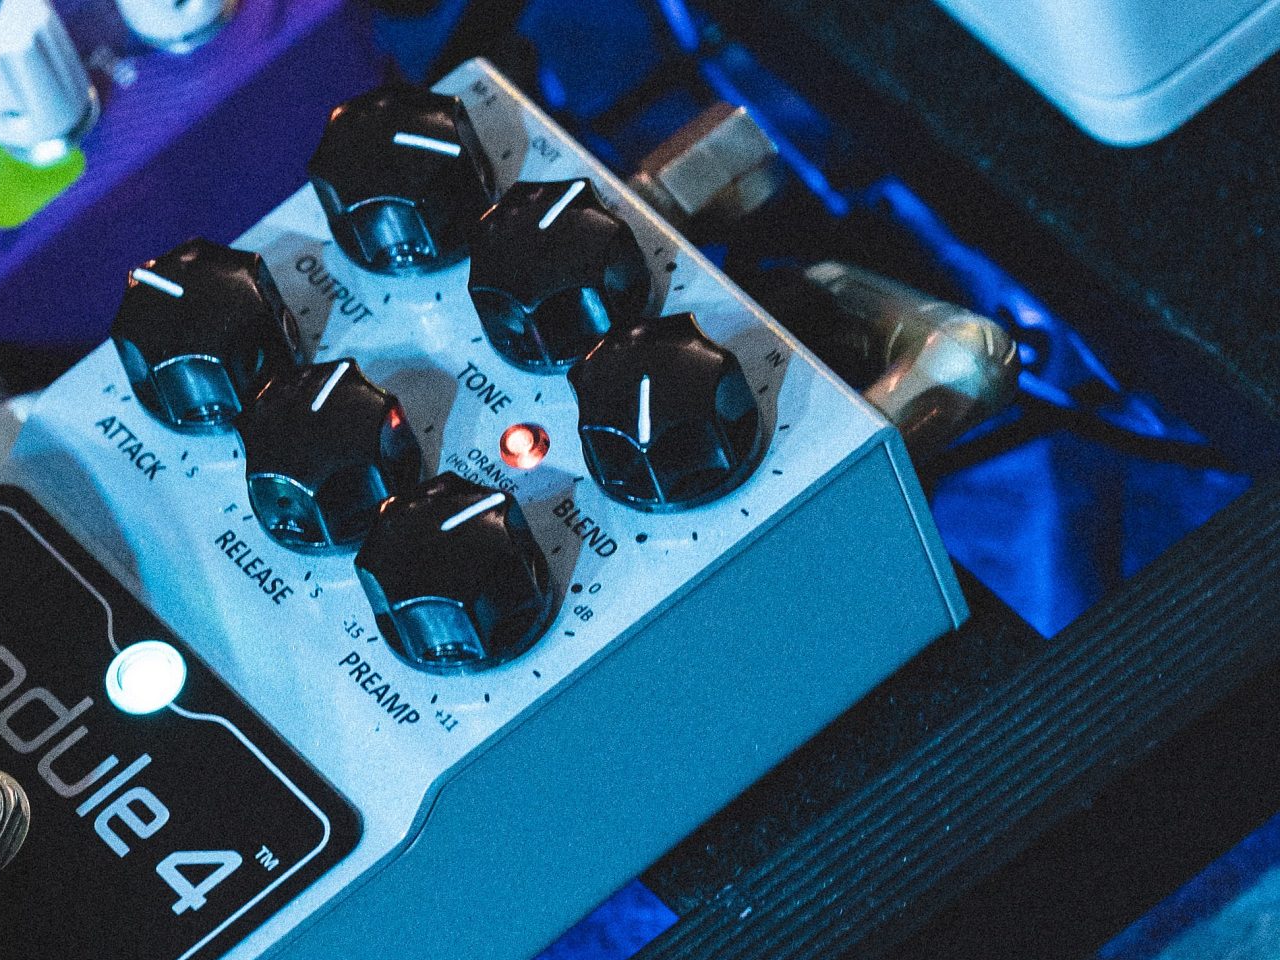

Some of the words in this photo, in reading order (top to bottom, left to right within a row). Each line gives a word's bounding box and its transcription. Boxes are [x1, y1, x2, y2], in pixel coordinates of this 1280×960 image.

[531, 135, 561, 163] OUT
[295, 255, 373, 324] OUTPUT
[456, 361, 512, 415] TONE
[765, 350, 785, 368] IN
[95, 415, 167, 481] ATTACK
[552, 498, 618, 558] BLEND
[214, 529, 295, 606] RELEASE
[343, 619, 365, 639] -15
[573, 605, 594, 623] dB
[338, 650, 421, 725] PREAMP
[155, 849, 243, 916] 4
